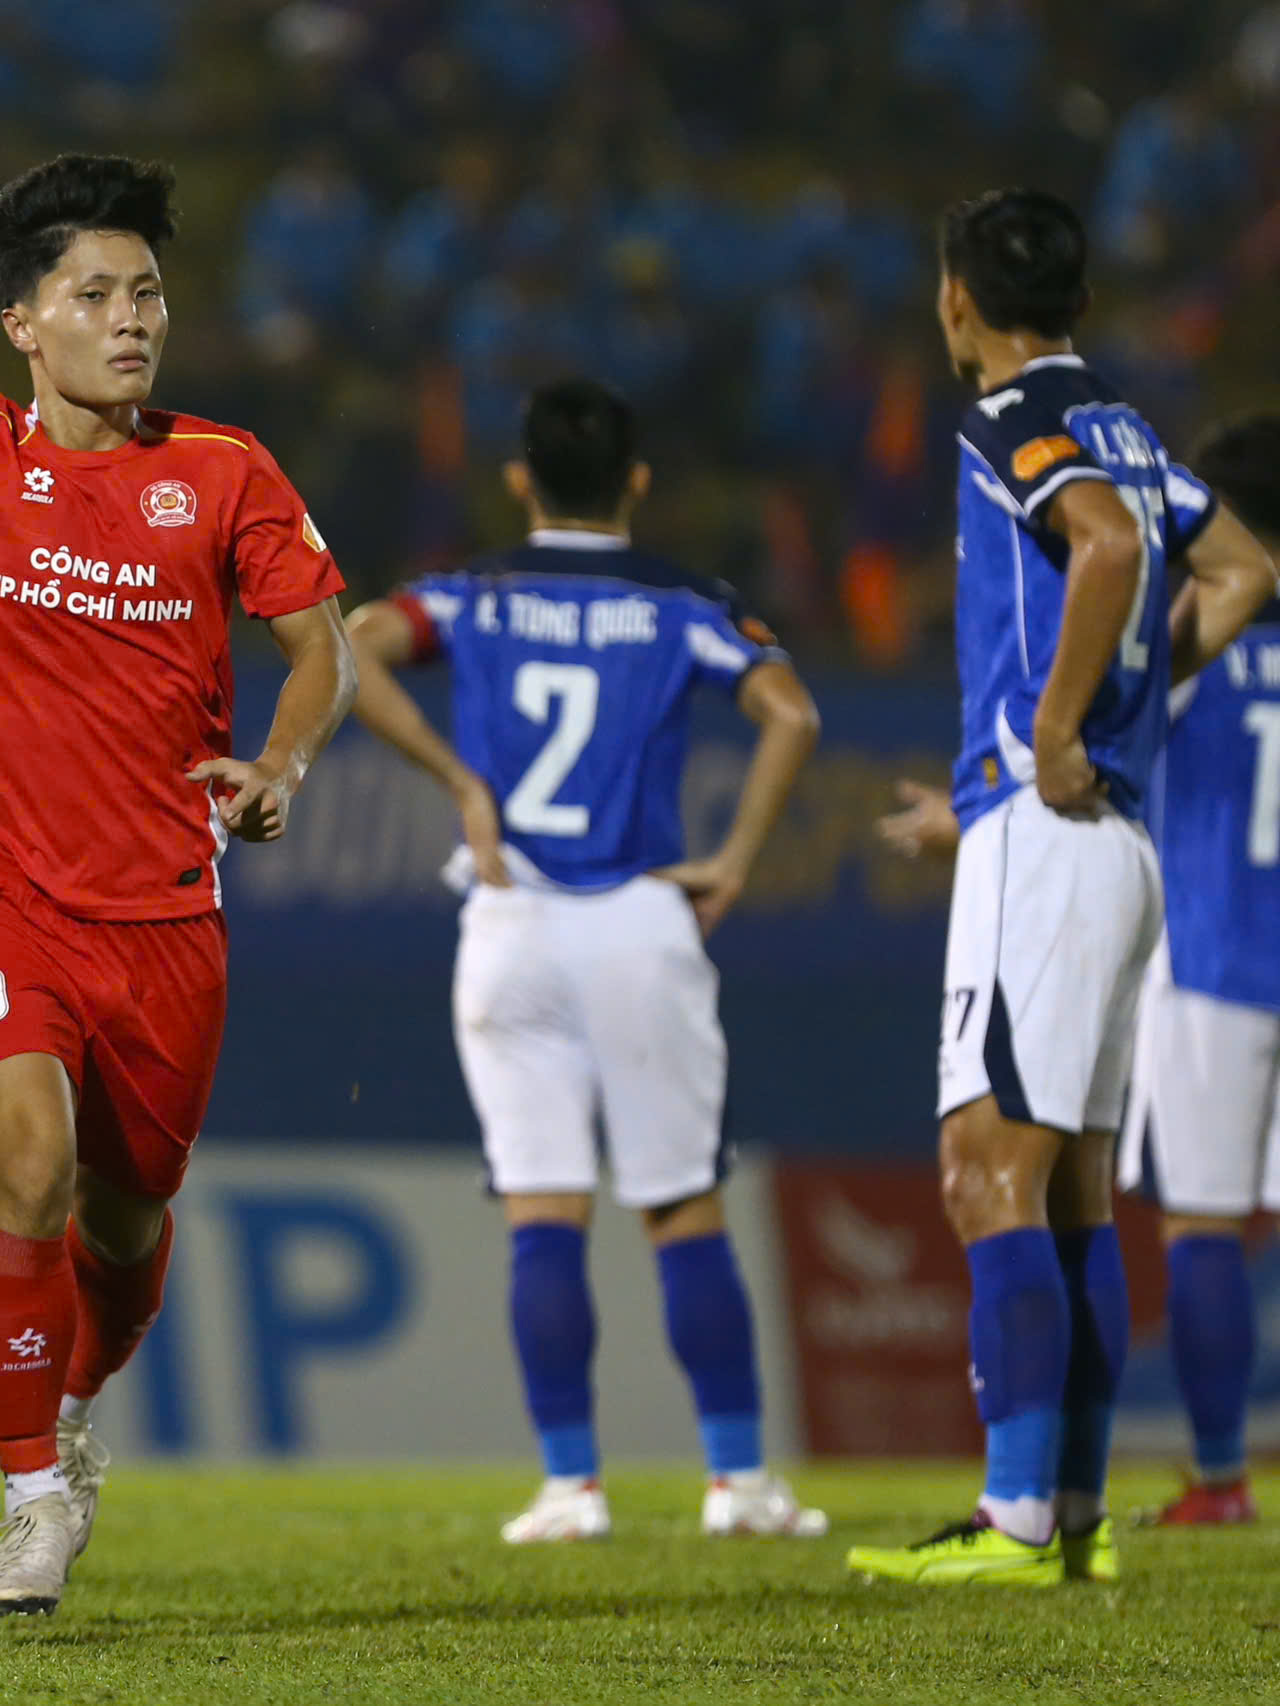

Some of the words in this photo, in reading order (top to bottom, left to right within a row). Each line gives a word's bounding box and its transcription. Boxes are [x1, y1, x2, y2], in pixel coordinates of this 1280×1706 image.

[29, 545, 110, 585] CÔNG
[115, 562, 156, 588] AN
[66, 592, 117, 621] CHÍ
[122, 599, 193, 622] MINH
[505, 661, 600, 837] 2
